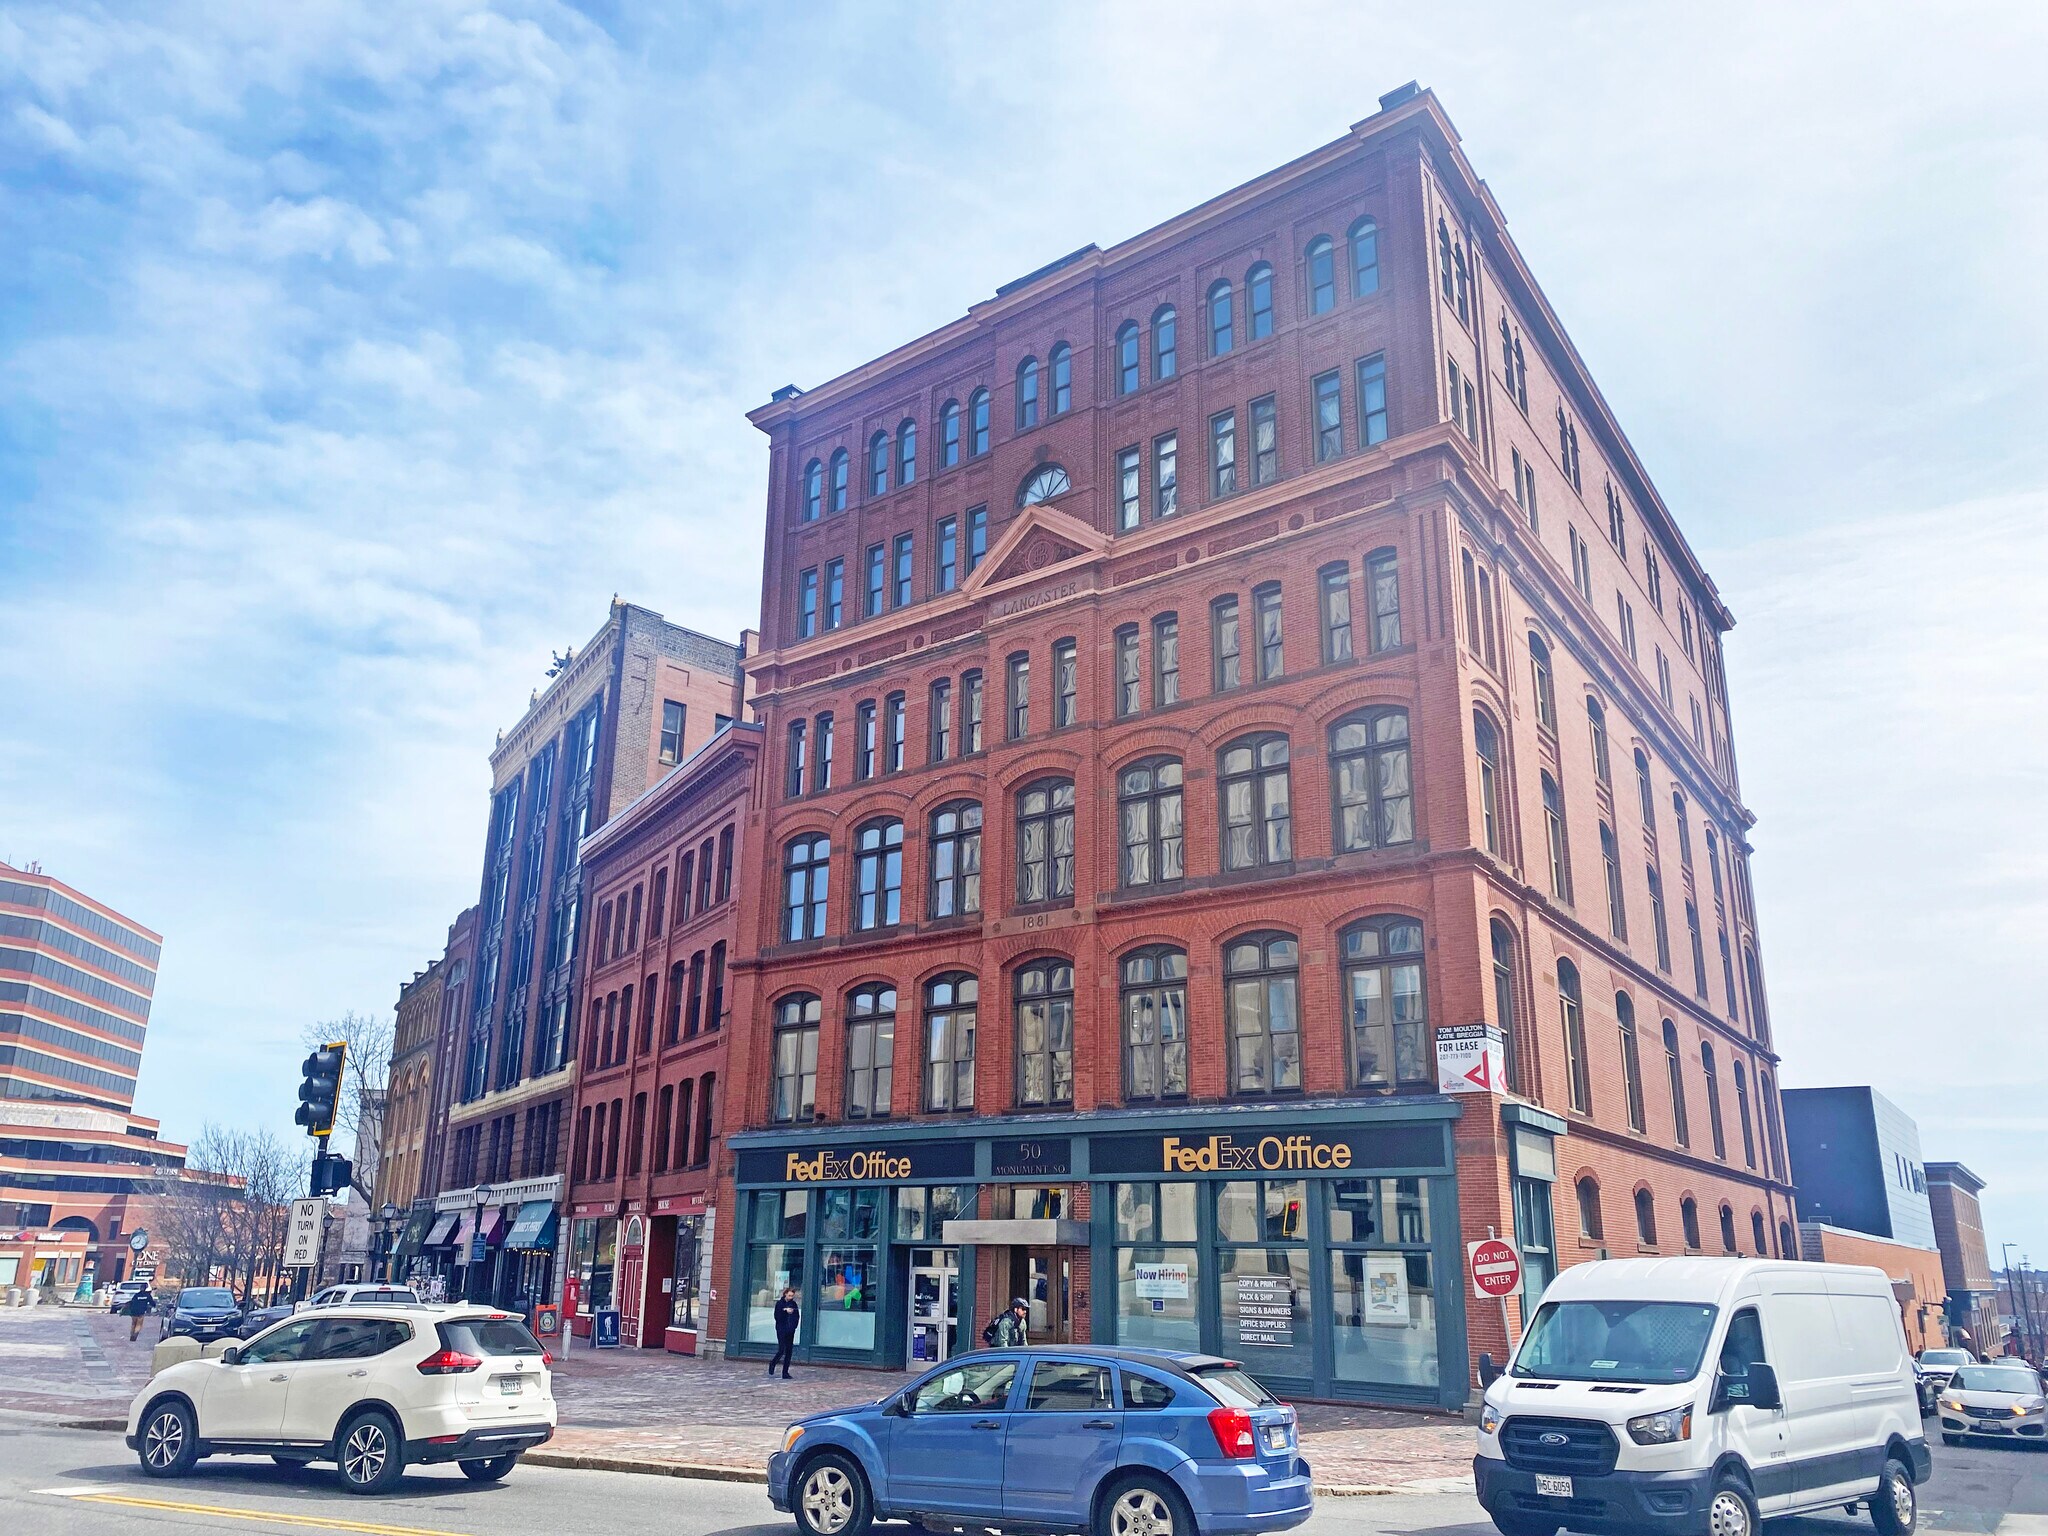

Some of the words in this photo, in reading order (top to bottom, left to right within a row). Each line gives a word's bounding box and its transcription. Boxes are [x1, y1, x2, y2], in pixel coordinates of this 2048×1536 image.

[1003, 582, 1077, 616] LANCASTER
[1023, 914, 1049, 929] 1881
[1439, 1043, 1453, 1052] FOR
[1456, 1041, 1478, 1051] LEASE
[1020, 1143, 1041, 1160] 50
[1163, 1135, 1256, 1172] FedEx
[1257, 1135, 1352, 1170] Office
[786, 1151, 849, 1181] FedEx
[849, 1151, 912, 1179] Office
[996, 1165, 1048, 1175] MONUMENT
[301, 1204, 314, 1216] NO
[297, 1221, 314, 1231] TURN
[298, 1235, 308, 1245] ON
[293, 1249, 308, 1259] RED
[1477, 1253, 1490, 1262] DO
[1493, 1250, 1510, 1260] NOT
[1136, 1269, 1157, 1280] Now
[1158, 1269, 1187, 1284] Hiring
[1484, 1275, 1511, 1286] ENTER
[1239, 1280, 1254, 1288] COPY
[1260, 1280, 1277, 1288] PRINT
[1239, 1293, 1254, 1301] PACK
[1254, 1293, 1259, 1301] &
[1240, 1306, 1257, 1314] SIGNS
[1263, 1307, 1292, 1316] BANNERS
[1240, 1320, 1259, 1328] OFFICE
[1260, 1320, 1287, 1329] SUPPLIES
[1241, 1333, 1260, 1341] DIRECT
[1260, 1334, 1276, 1342] MAIL
